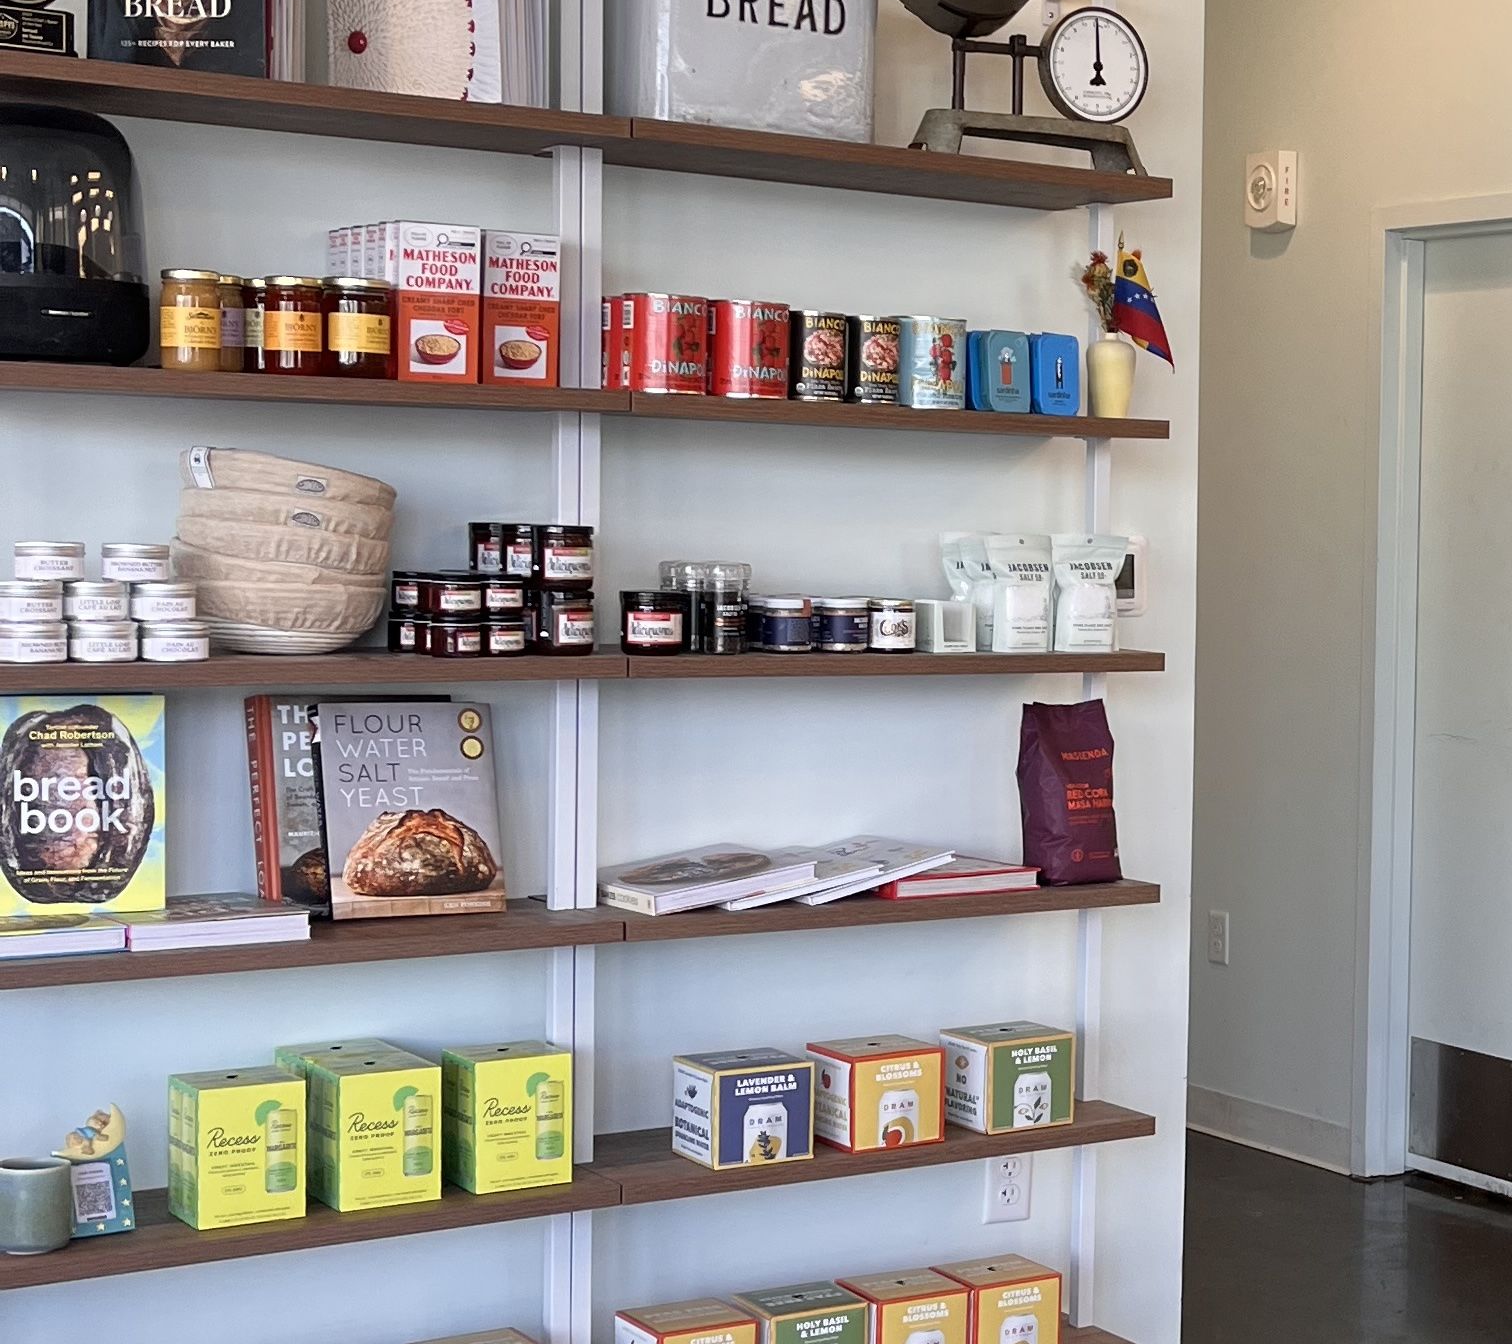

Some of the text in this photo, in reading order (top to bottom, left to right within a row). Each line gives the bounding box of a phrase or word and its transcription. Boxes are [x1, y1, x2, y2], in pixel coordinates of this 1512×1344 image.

[210, 40, 235, 48] BAKER
[403, 248, 477, 265] MATHESON
[421, 263, 458, 277] FOOD
[488, 256, 558, 273] MATHESON
[405, 275, 473, 291] COMPANY
[505, 271, 540, 284] FOOD
[491, 283, 554, 298] COMPANY
[1007, 562, 1049, 573] JACOBSEN
[1069, 561, 1113, 572] JACOBSEN
[1019, 573, 1034, 582] SALT
[1080, 571, 1096, 580] SALT
[276, 704, 308, 725] TH
[334, 714, 423, 734] FLOUR
[29, 730, 115, 740] Chad Robertson
[336, 738, 427, 758] WATER
[338, 762, 400, 783] SALT
[13, 768, 130, 802] bread
[246, 707, 265, 899] THE PERFECT LOA
[339, 786, 424, 807] YEAST
[20, 800, 128, 834] book
[1011, 1048, 1033, 1058] HOLY
[1023, 1054, 1052, 1064] LEMON
[875, 1068, 922, 1082] BLOSSOMS
[880, 1062, 911, 1074] CITRUS
[737, 1074, 795, 1088] LAVENDER &
[956, 1073, 967, 1085] NO
[735, 1082, 797, 1096] LEMON BALM
[483, 1097, 531, 1119] Recess
[347, 1112, 399, 1133] Recess
[207, 1127, 261, 1149] Recess
[997, 1294, 1042, 1308] BLOSSOMS
[1002, 1289, 1031, 1299] CITRUS
[902, 1309, 949, 1323] BLOSSOMS
[907, 1304, 937, 1315] CITRUS
[796, 1315, 849, 1332] HOLY BASIL
[1004, 1325, 1034, 1336] DRAM
[809, 1325, 843, 1337] LEMON
